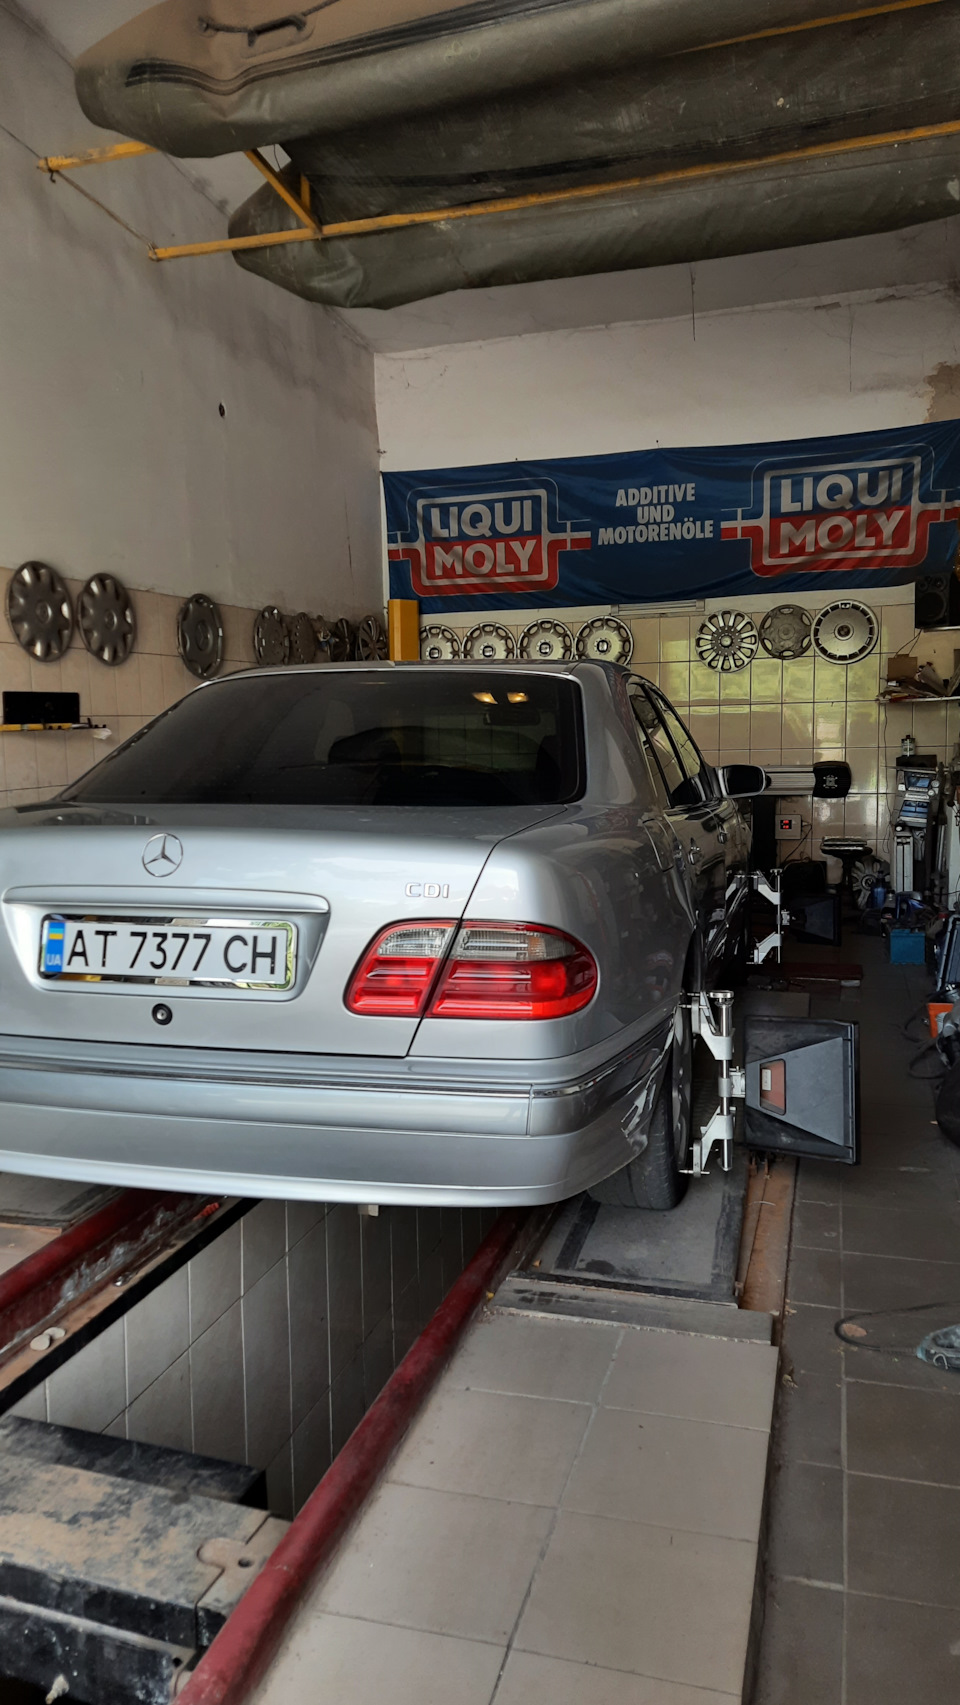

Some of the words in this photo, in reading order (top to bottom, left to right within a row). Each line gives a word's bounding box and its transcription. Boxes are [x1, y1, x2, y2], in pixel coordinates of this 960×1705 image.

[615, 483, 696, 507] ADDITIVE
[780, 468, 904, 513] LIQUI
[430, 500, 532, 537] LIQUI
[637, 504, 675, 524] UND
[598, 517, 714, 545] MOTORENÖLE
[779, 510, 905, 554] MOLY
[433, 540, 537, 576] MOLY
[405, 882, 450, 899] CDI
[46, 953, 63, 966] UA
[66, 929, 117, 968] AT
[129, 931, 212, 972] 7377
[223, 934, 277, 975] CH
